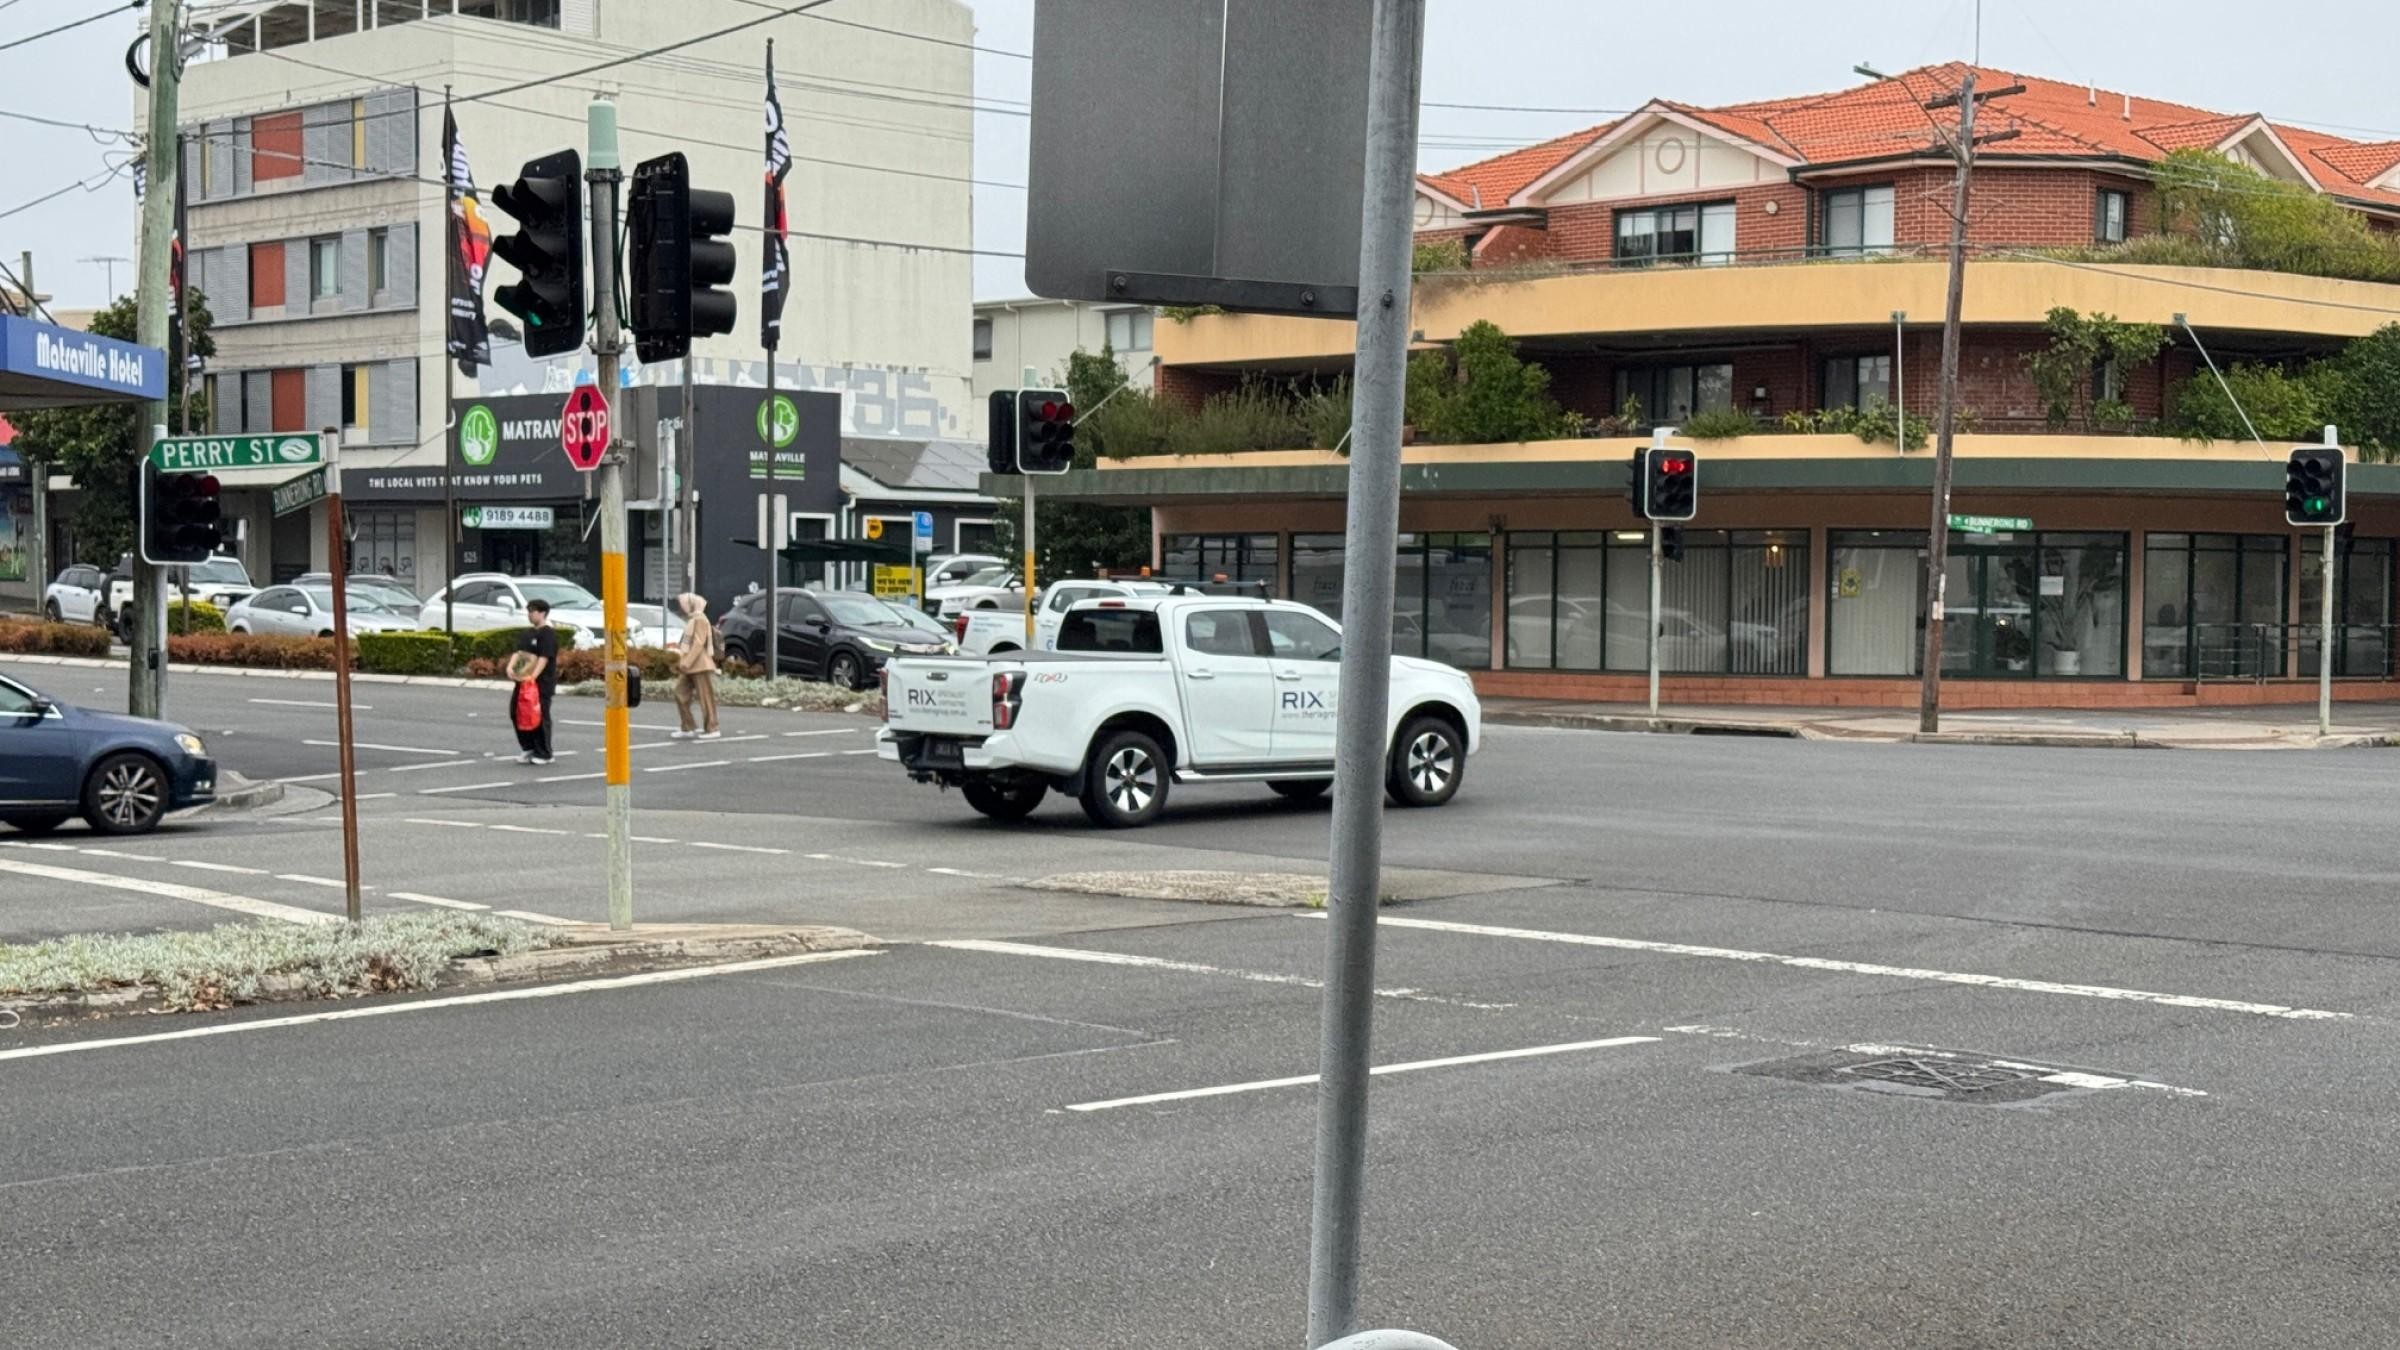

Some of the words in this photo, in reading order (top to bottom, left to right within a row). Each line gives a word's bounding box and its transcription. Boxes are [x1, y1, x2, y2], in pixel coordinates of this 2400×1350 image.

[36, 331, 107, 379] Matraville
[109, 348, 143, 388] Hotel
[502, 418, 562, 441] MATRAV
[566, 410, 607, 445] STOP
[162, 440, 236, 467] PERRY
[250, 438, 275, 463] ST
[749, 451, 806, 464] MATAVILLE
[369, 477, 385, 488] THE
[387, 477, 413, 488] LOCAL
[416, 476, 437, 487] VETS
[439, 475, 461, 487] TAT
[463, 474, 491, 486] KNOW
[493, 474, 517, 485] YOUR
[520, 473, 542, 484] PETS
[486, 510, 514, 521] 9189
[518, 511, 550, 522] 4488
[908, 688, 937, 706] RIX
[1282, 691, 1325, 709] RIX
